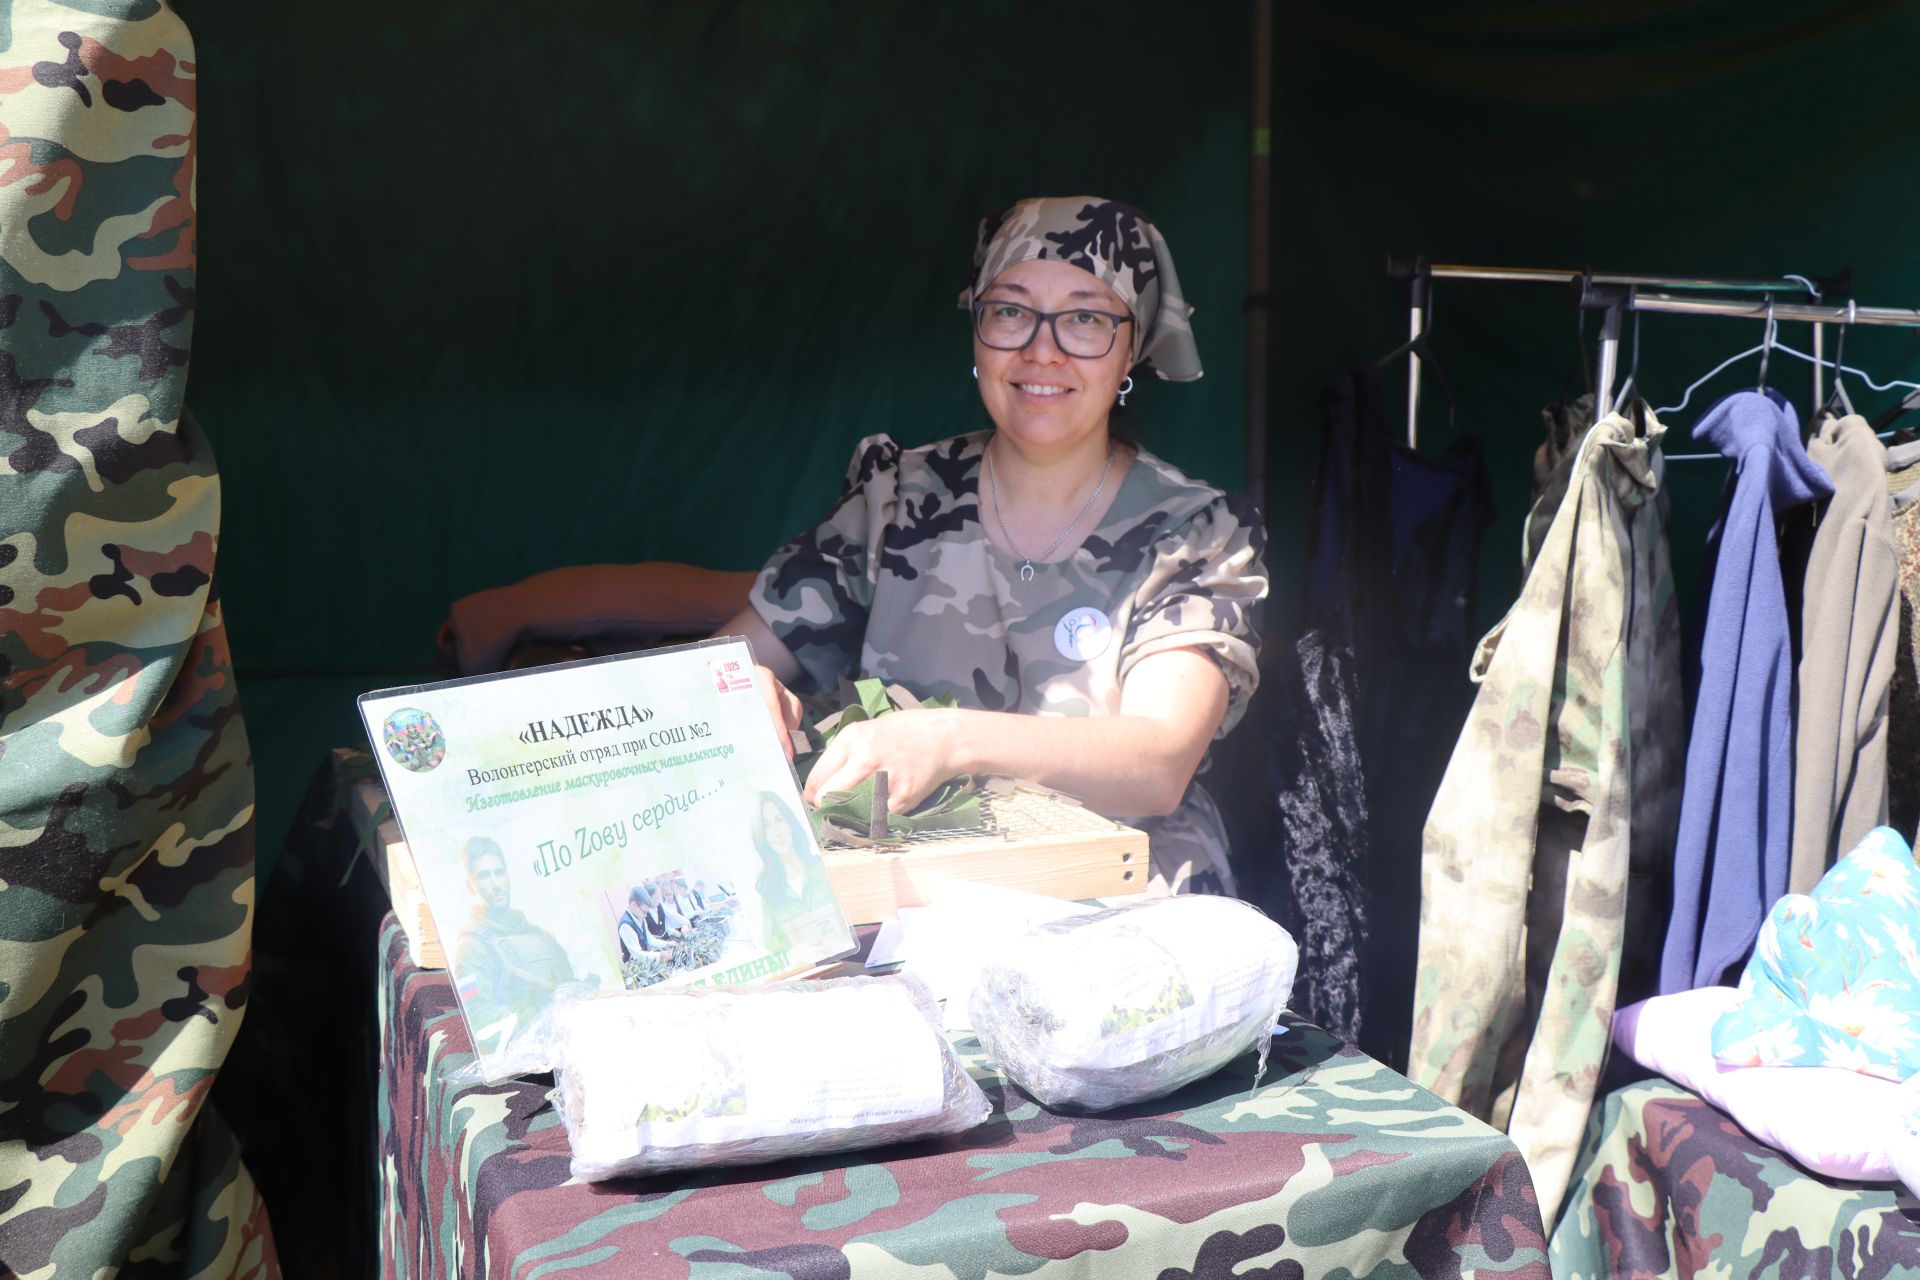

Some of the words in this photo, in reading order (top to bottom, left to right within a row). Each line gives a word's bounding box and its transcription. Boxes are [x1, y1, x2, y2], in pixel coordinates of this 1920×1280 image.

[723, 661, 740, 672] 2025
[466, 749, 577, 786] Волонтерский
[580, 743, 621, 764] отряд
[622, 738, 648, 756] при
[650, 726, 687, 748] СОШ
[689, 721, 713, 741] №2
[518, 703, 654, 746] «НАДЕЖДА»
[465, 780, 562, 813] Изготовление
[564, 759, 661, 787] маскировочных
[661, 743, 735, 769] нашлемников
[533, 839, 572, 878] «По
[574, 819, 628, 860] Zову
